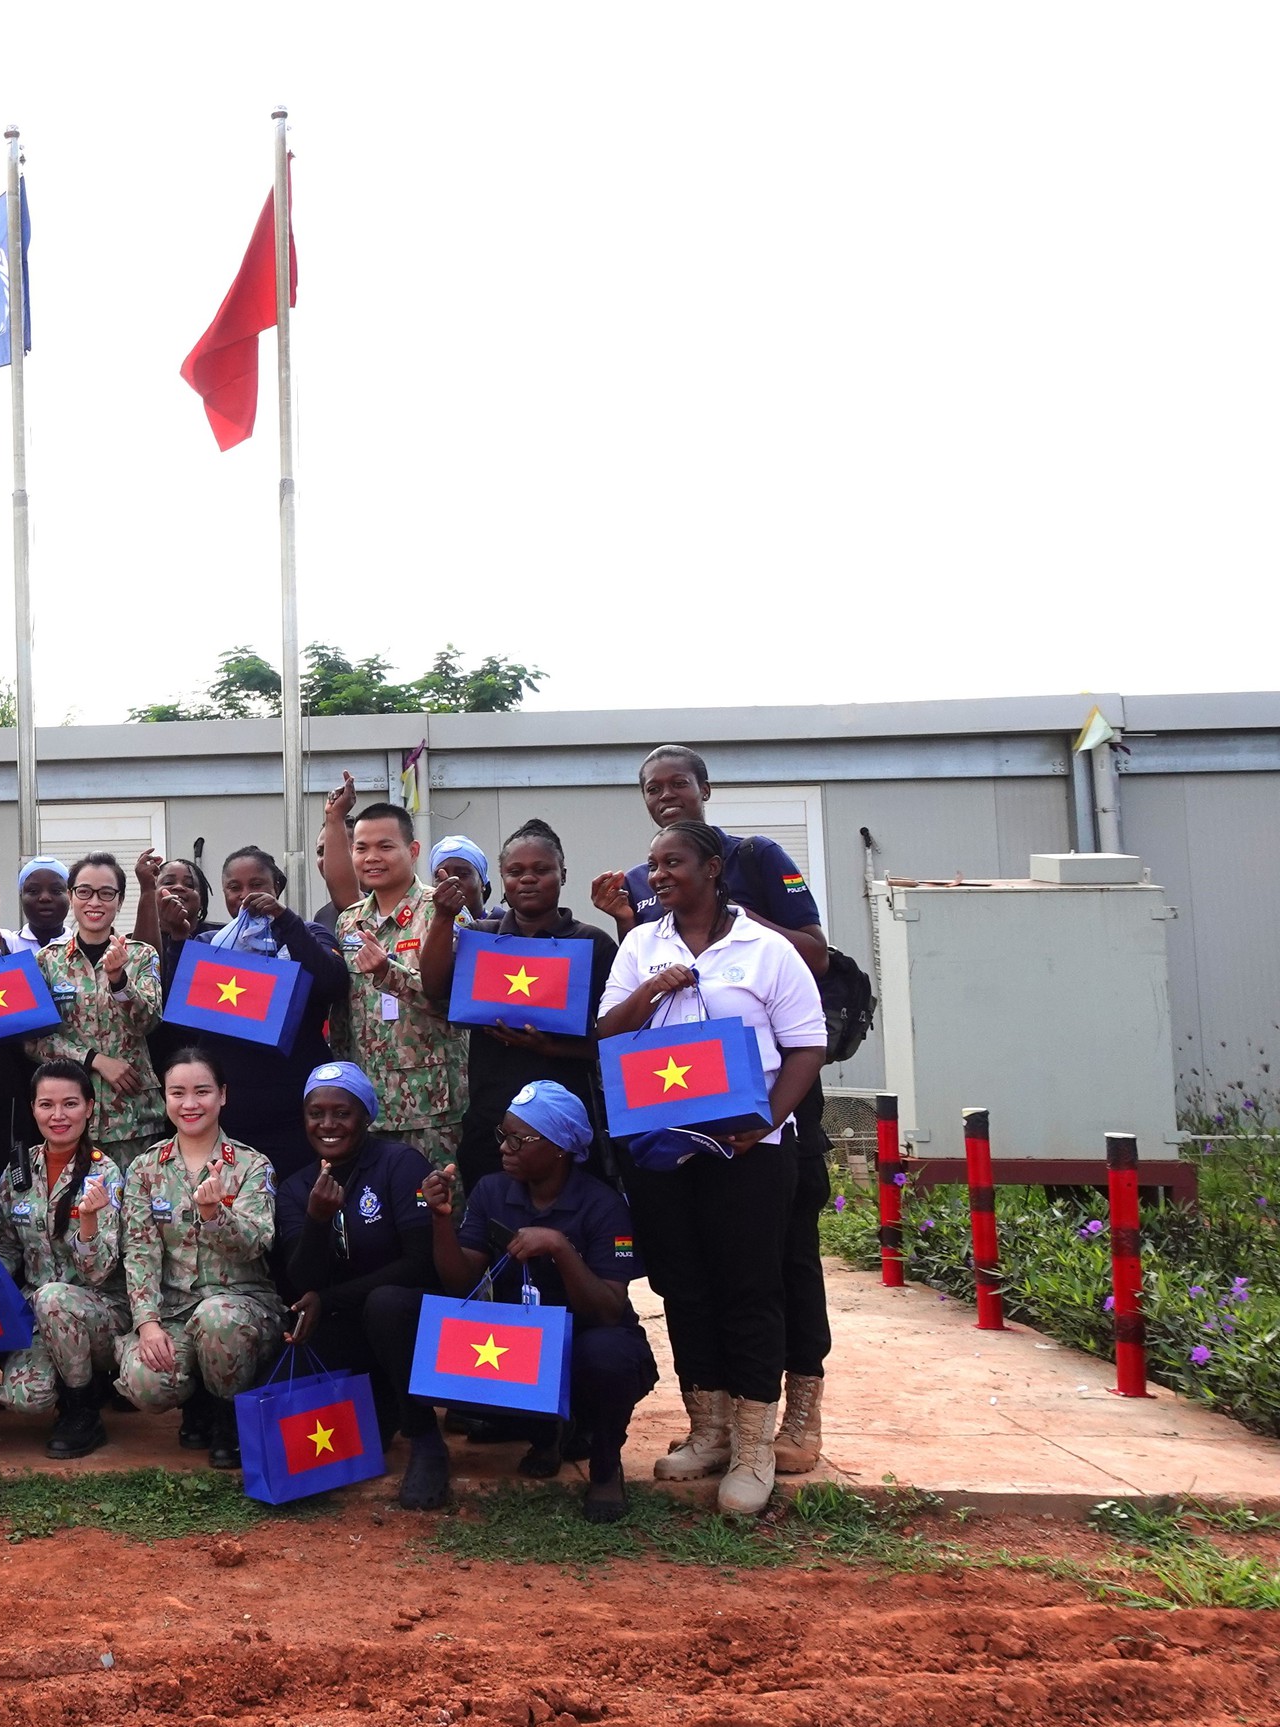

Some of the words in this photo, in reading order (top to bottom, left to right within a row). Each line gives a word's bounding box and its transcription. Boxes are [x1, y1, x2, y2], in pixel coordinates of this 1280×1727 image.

[786, 885, 808, 894] POLICE
[636, 895, 657, 913] FPU
[364, 1214, 382, 1224] POLICE
